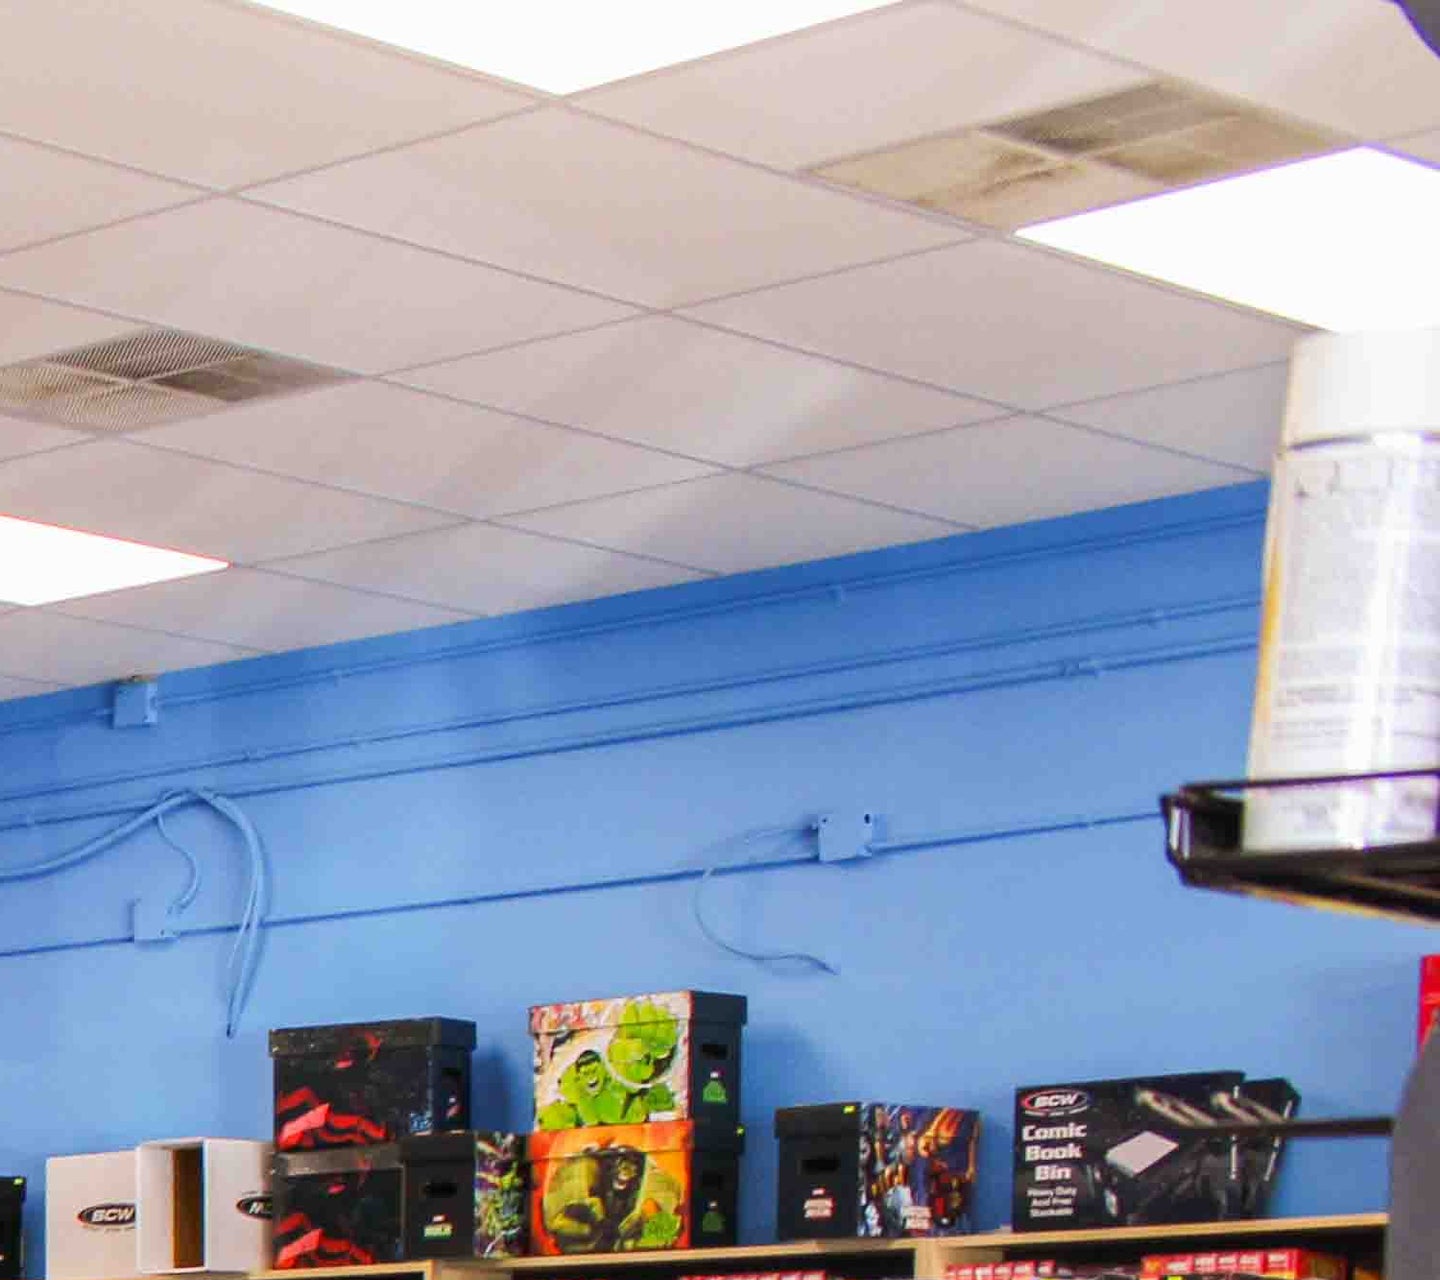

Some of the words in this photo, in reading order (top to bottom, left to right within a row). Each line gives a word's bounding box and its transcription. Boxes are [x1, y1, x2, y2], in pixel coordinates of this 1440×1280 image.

[1033, 1093, 1079, 1107] BCW
[1021, 1121, 1088, 1141] Comic
[1024, 1143, 1083, 1162] Book
[1034, 1164, 1072, 1182] Bin
[89, 1207, 136, 1223] BCW
